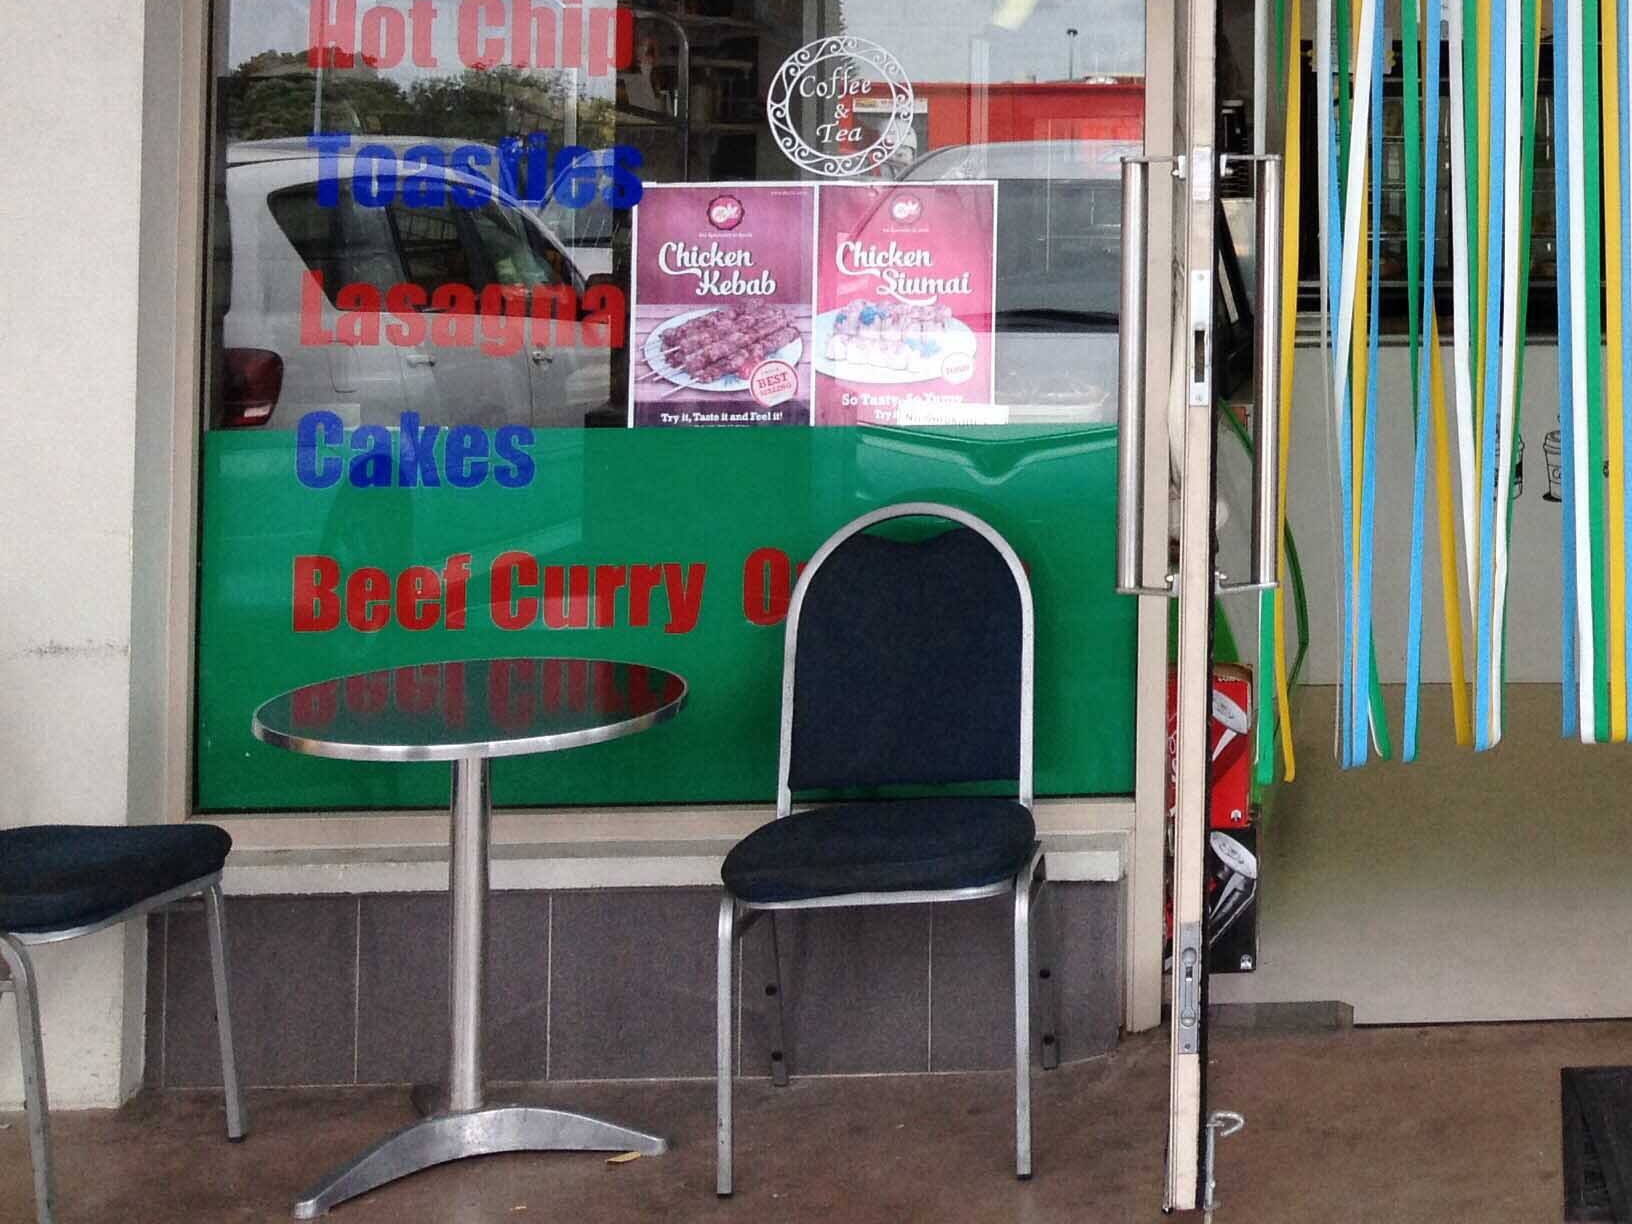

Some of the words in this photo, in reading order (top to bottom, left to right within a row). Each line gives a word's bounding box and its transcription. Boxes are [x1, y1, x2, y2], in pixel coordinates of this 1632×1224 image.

[800, 66, 872, 99] Coffee
[834, 103, 849, 119] &
[816, 121, 863, 143] Tea
[308, 132, 643, 210] Toasties
[658, 241, 754, 276] Chicken
[836, 240, 933, 276] Chicken
[695, 269, 777, 295] Kebab
[876, 269, 972, 305] Siumai
[300, 269, 627, 358] Lasagna
[757, 372, 788, 389] BEST
[841, 393, 858, 406] So
[660, 413, 680, 424] Try
[693, 412, 720, 422] Taste
[721, 412, 729, 421] it
[730, 412, 749, 422] and
[750, 411, 772, 422] Feel
[296, 411, 535, 489] Cakes
[292, 551, 472, 632] Beef
[489, 551, 707, 634] Curry
[742, 546, 806, 626] O
